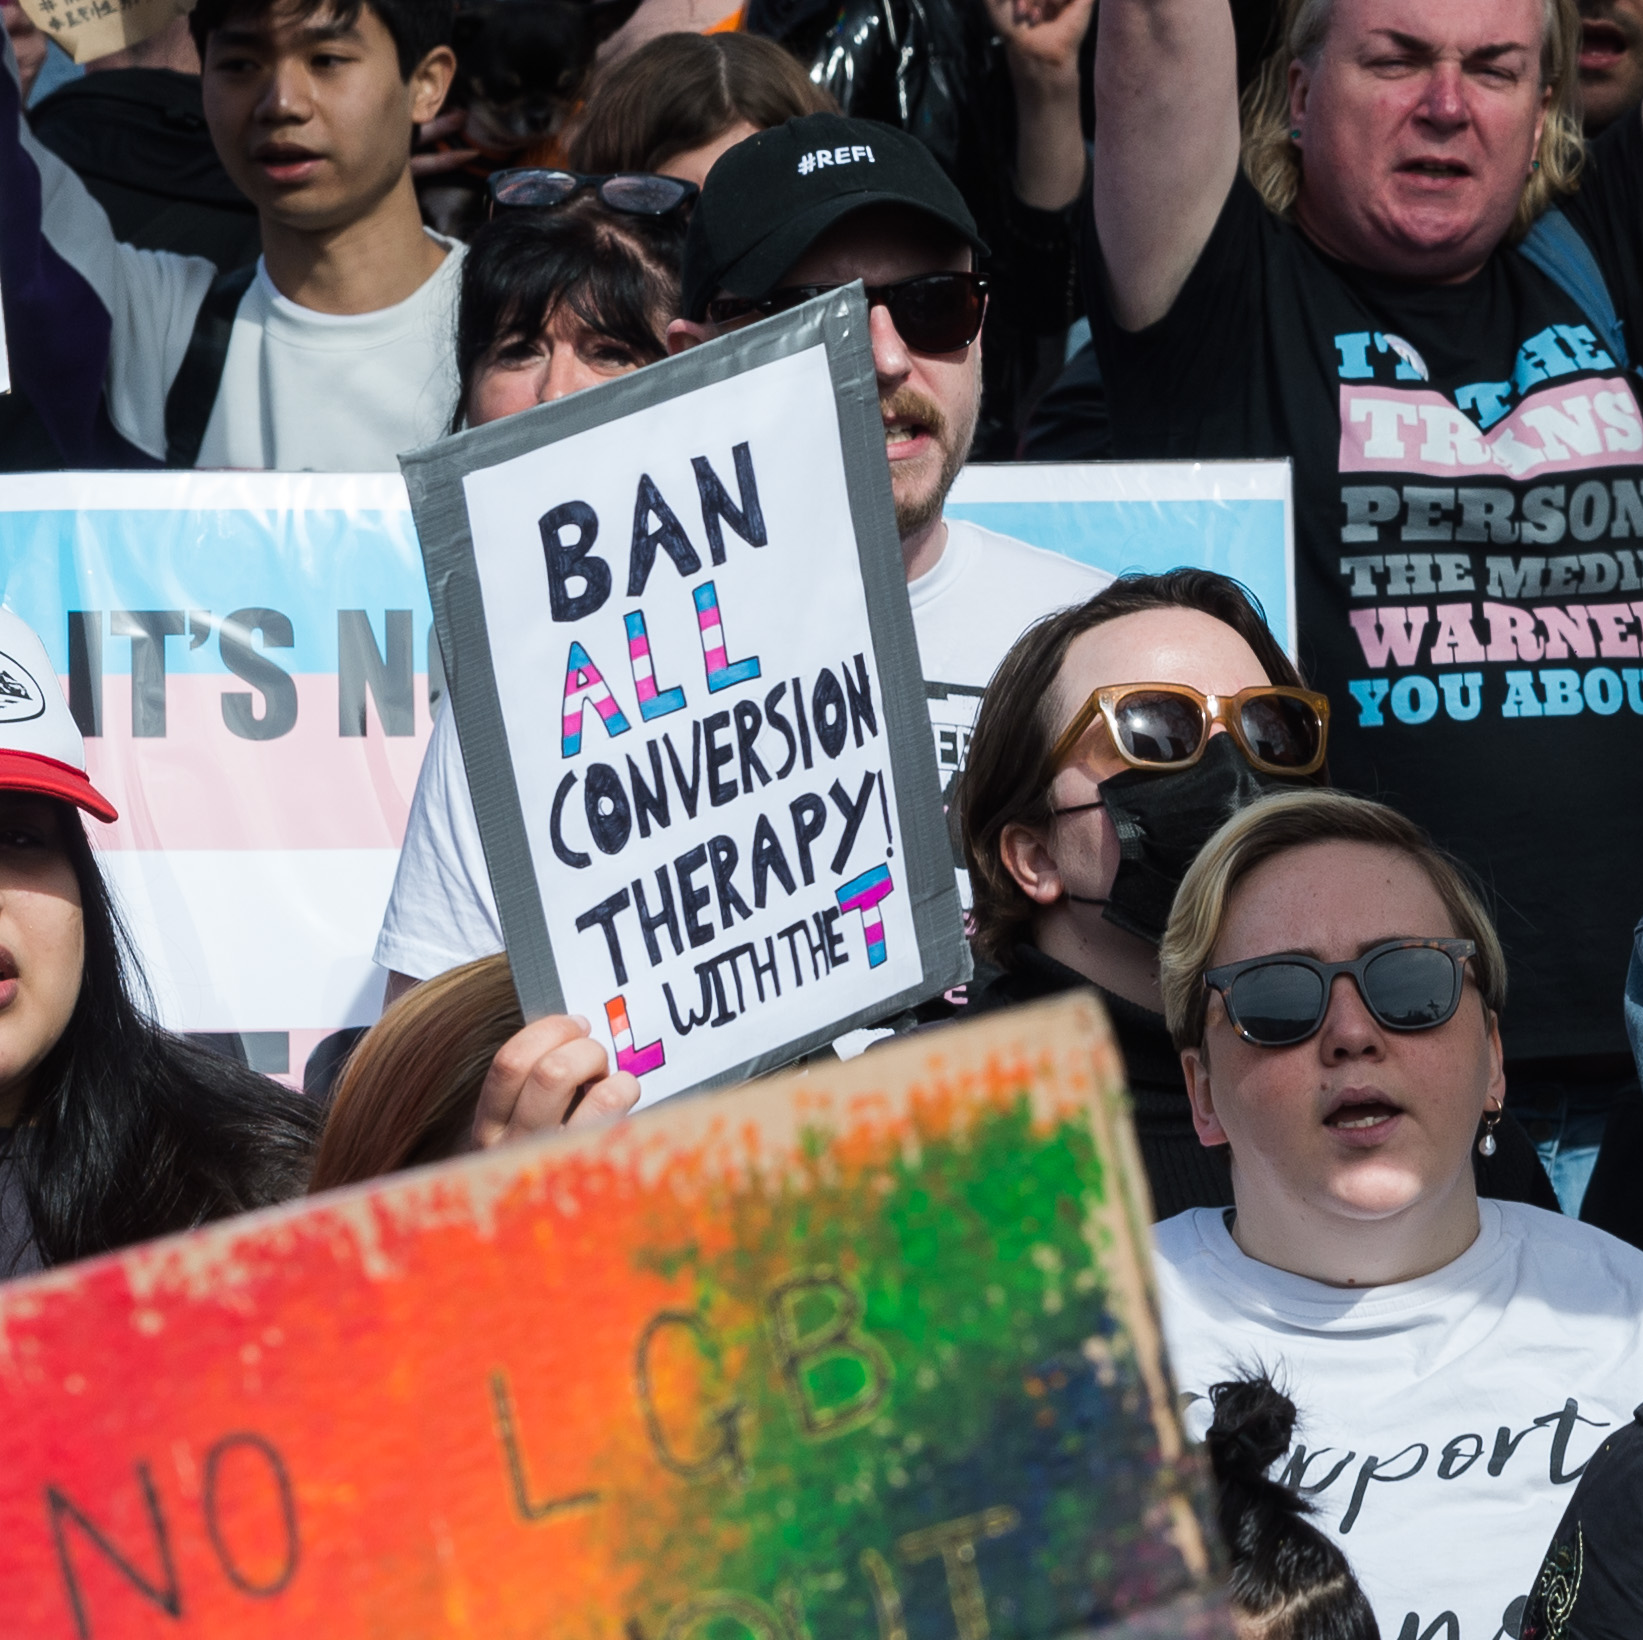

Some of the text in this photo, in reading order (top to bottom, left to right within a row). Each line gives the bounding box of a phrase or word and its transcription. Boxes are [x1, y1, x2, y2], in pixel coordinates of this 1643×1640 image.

[537, 440, 768, 623] BAN
[1340, 554, 1476, 597] THE
[67, 606, 299, 742] IT'S
[561, 580, 762, 759] ALL
[1348, 671, 1484, 727] YOU
[550, 653, 879, 869] CONVERSION
[576, 768, 894, 988] THERAPY!
[661, 936, 782, 1036] WITH
[777, 906, 850, 988] THE
[835, 862, 895, 970] T
[42, 1430, 303, 1640] NO
